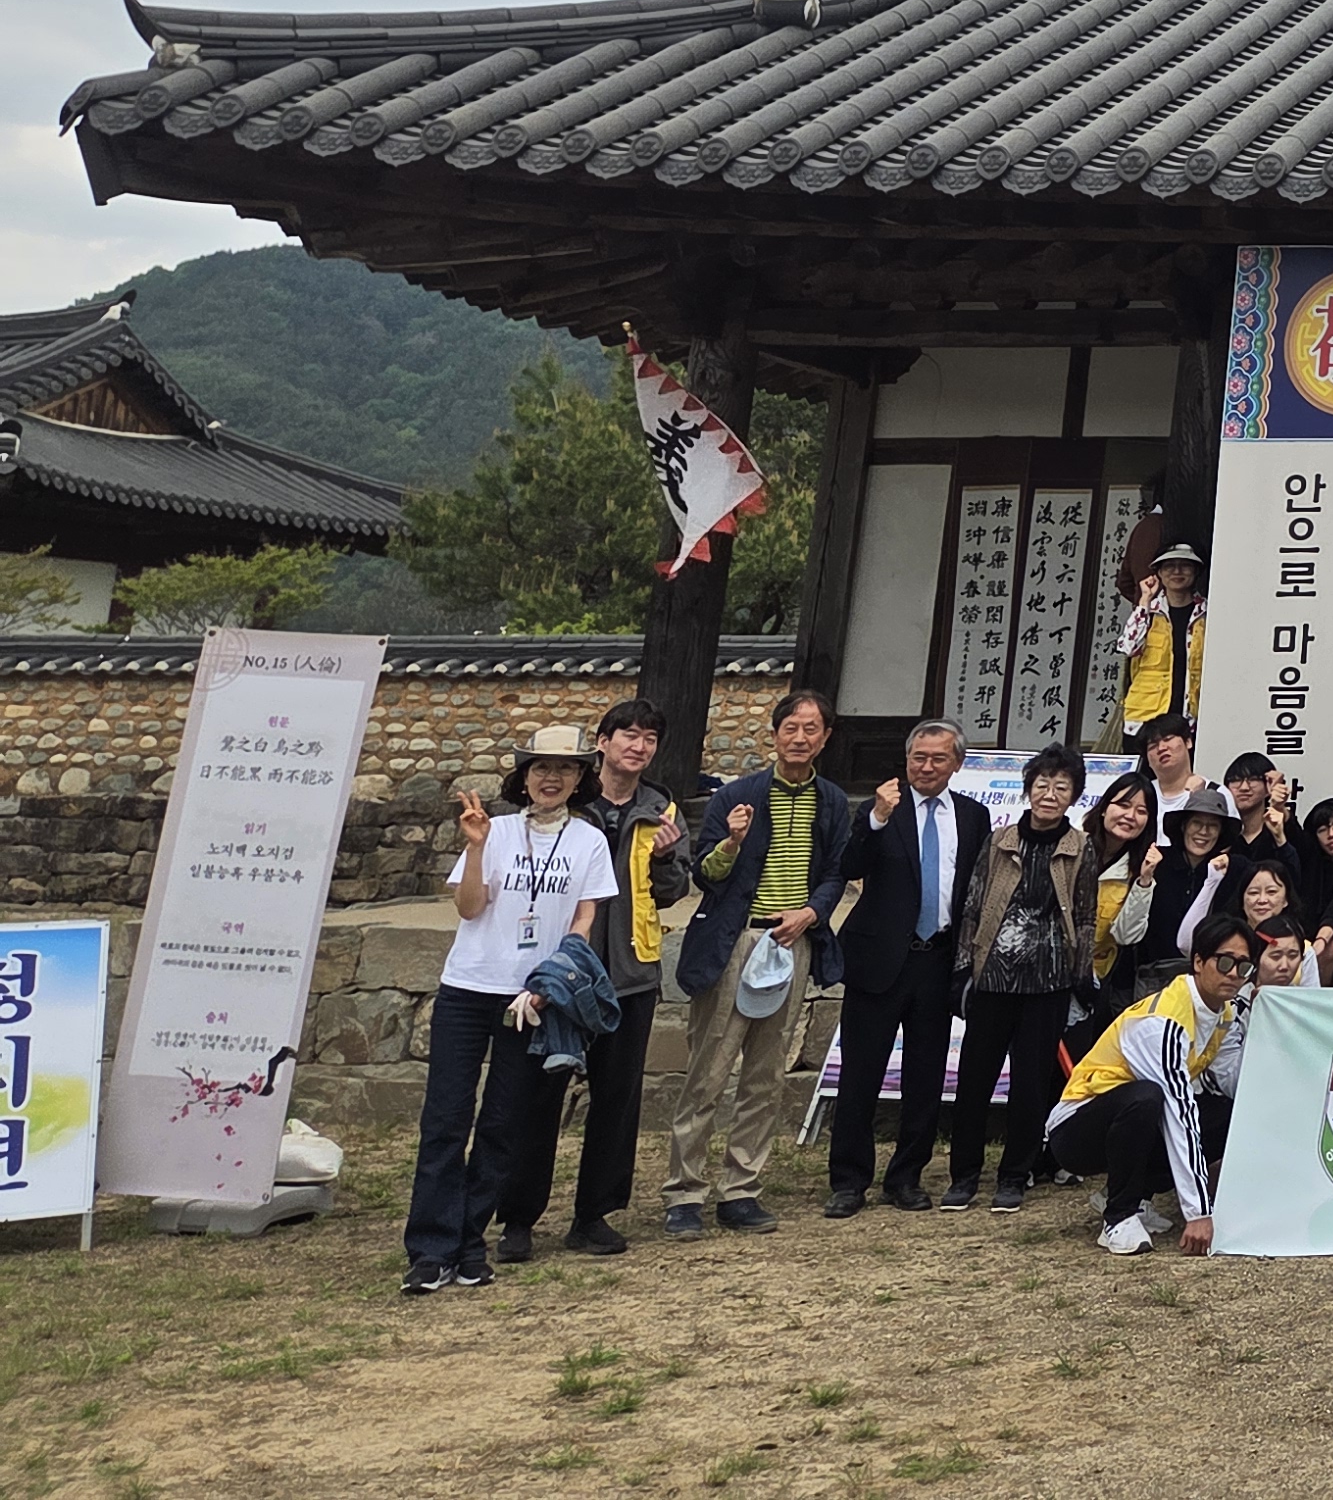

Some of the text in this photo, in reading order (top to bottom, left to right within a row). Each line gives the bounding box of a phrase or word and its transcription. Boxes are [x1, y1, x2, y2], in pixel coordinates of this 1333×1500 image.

[242, 655, 343, 675] NO.15 (人倫)
[1264, 473, 1327, 756] 안으로 마음을
